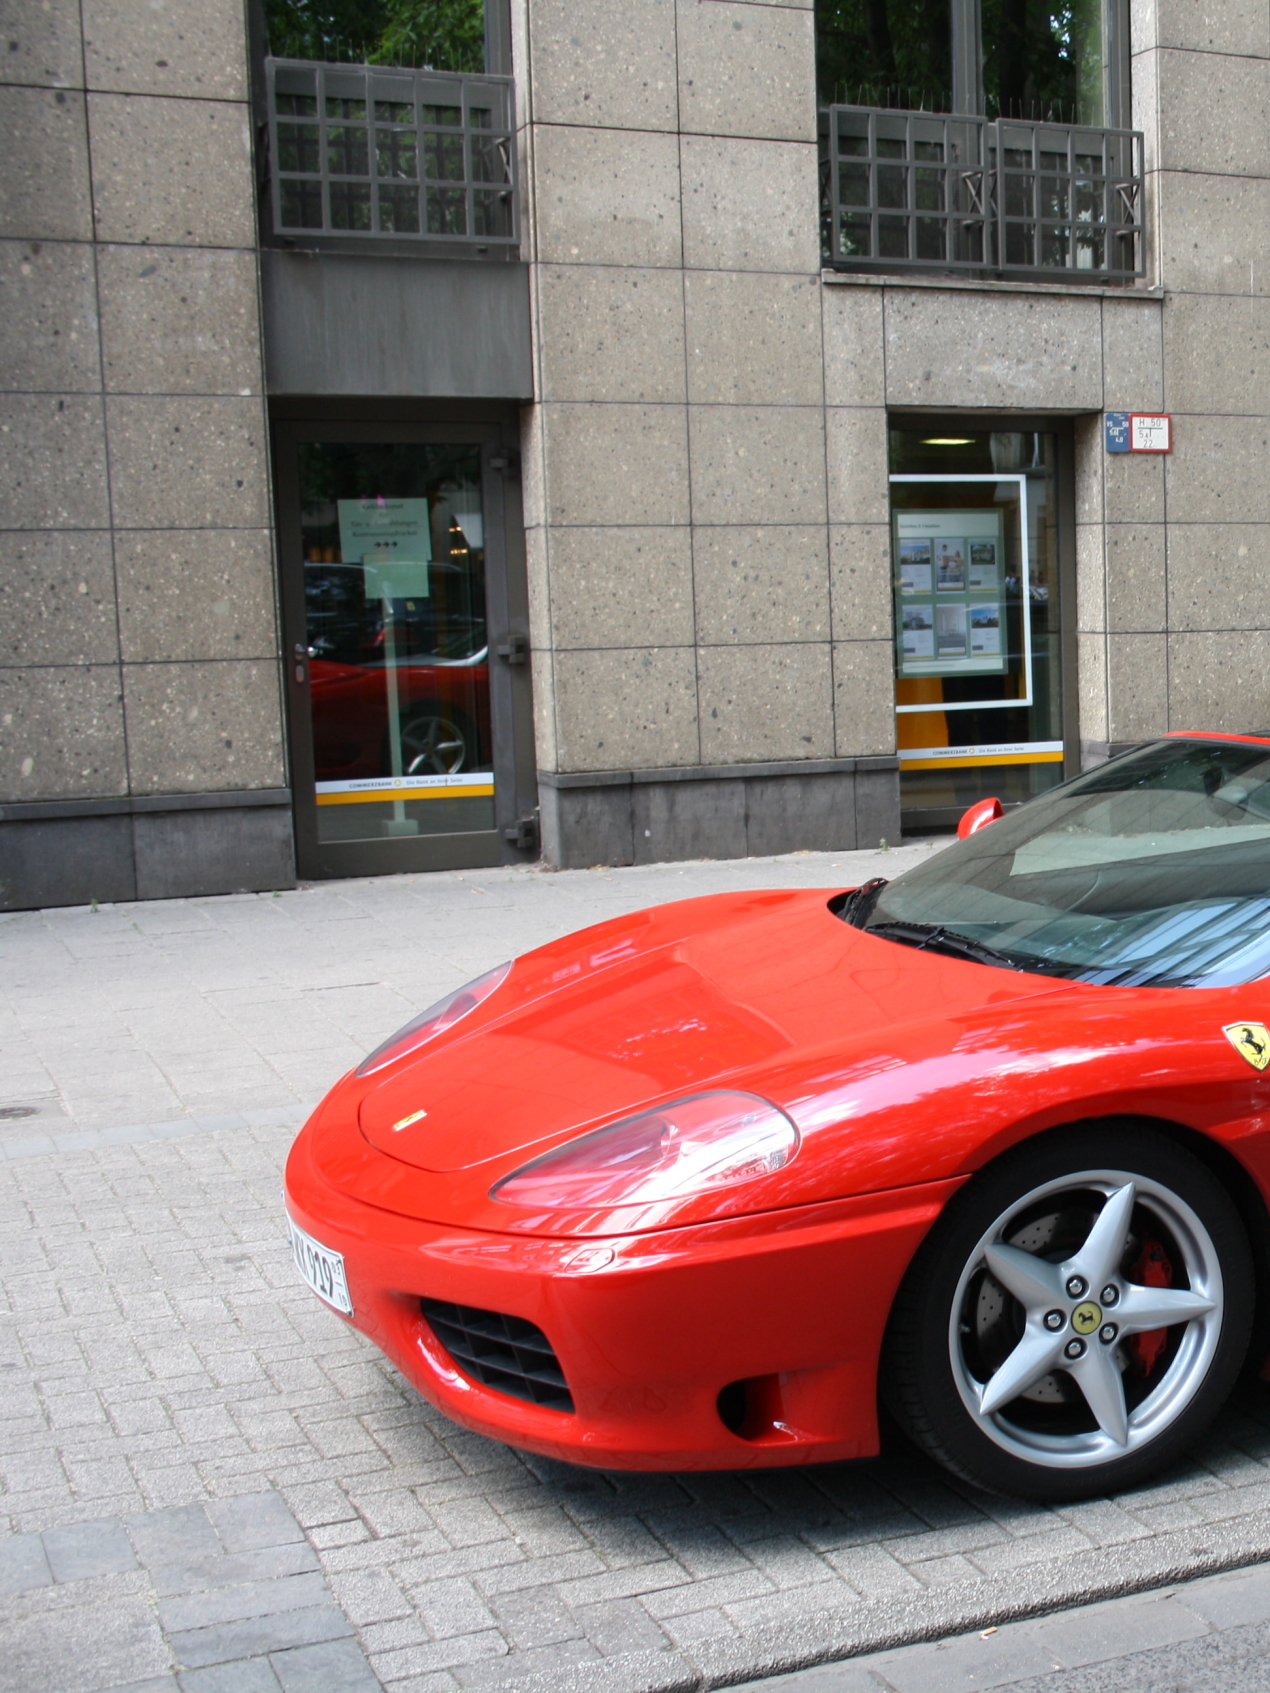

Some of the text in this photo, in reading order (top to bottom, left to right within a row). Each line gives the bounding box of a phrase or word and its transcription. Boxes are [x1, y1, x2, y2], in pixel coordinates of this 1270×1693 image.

[1139, 418, 1161, 427] H 50
[1143, 439, 1153, 449] 22
[349, 780, 392, 789] COMMERZBANK
[307, 1244, 334, 1299] 919
